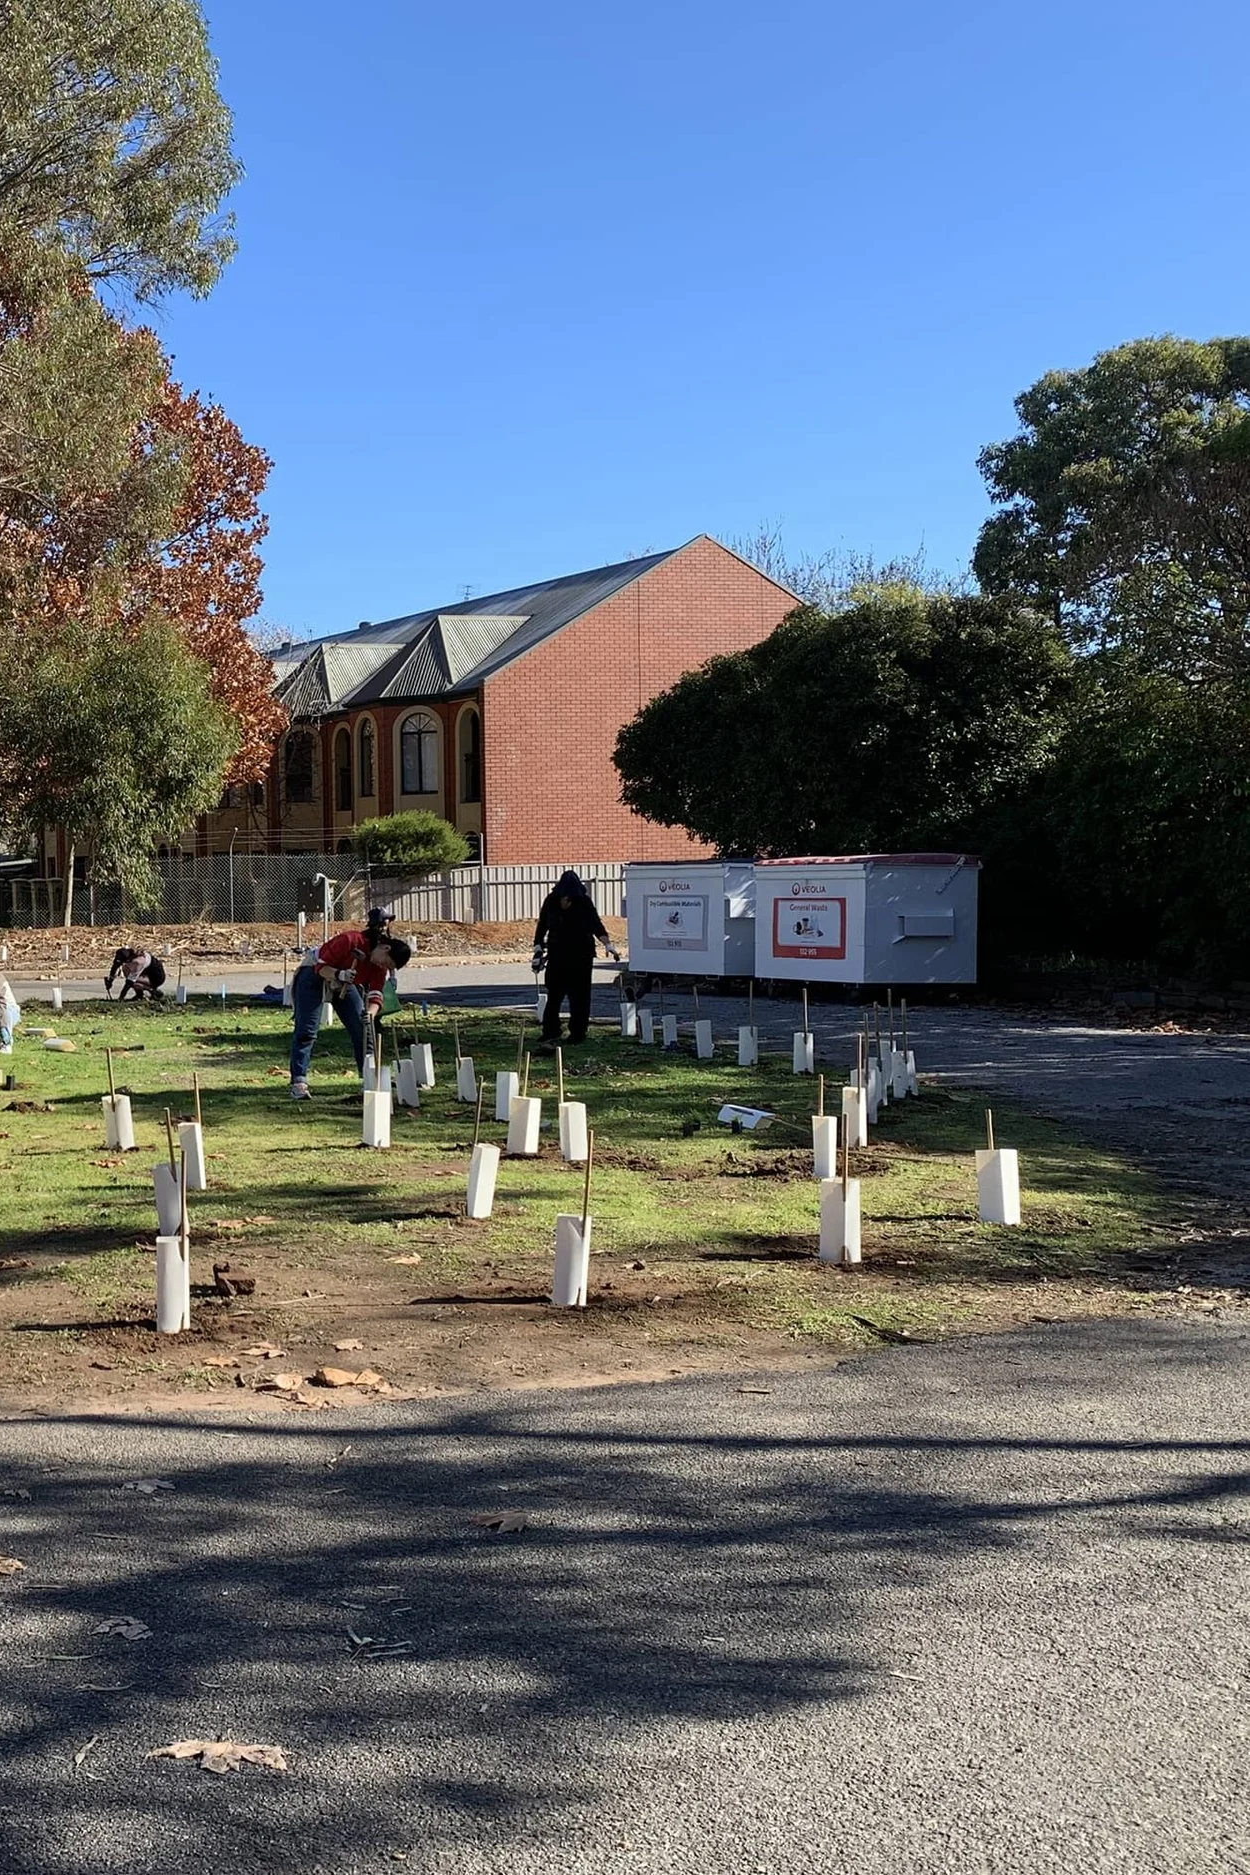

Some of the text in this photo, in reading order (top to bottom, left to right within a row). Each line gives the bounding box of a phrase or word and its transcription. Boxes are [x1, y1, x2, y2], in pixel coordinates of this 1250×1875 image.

[668, 883, 691, 891] VEOLIA
[789, 903, 828, 912] General Waste
